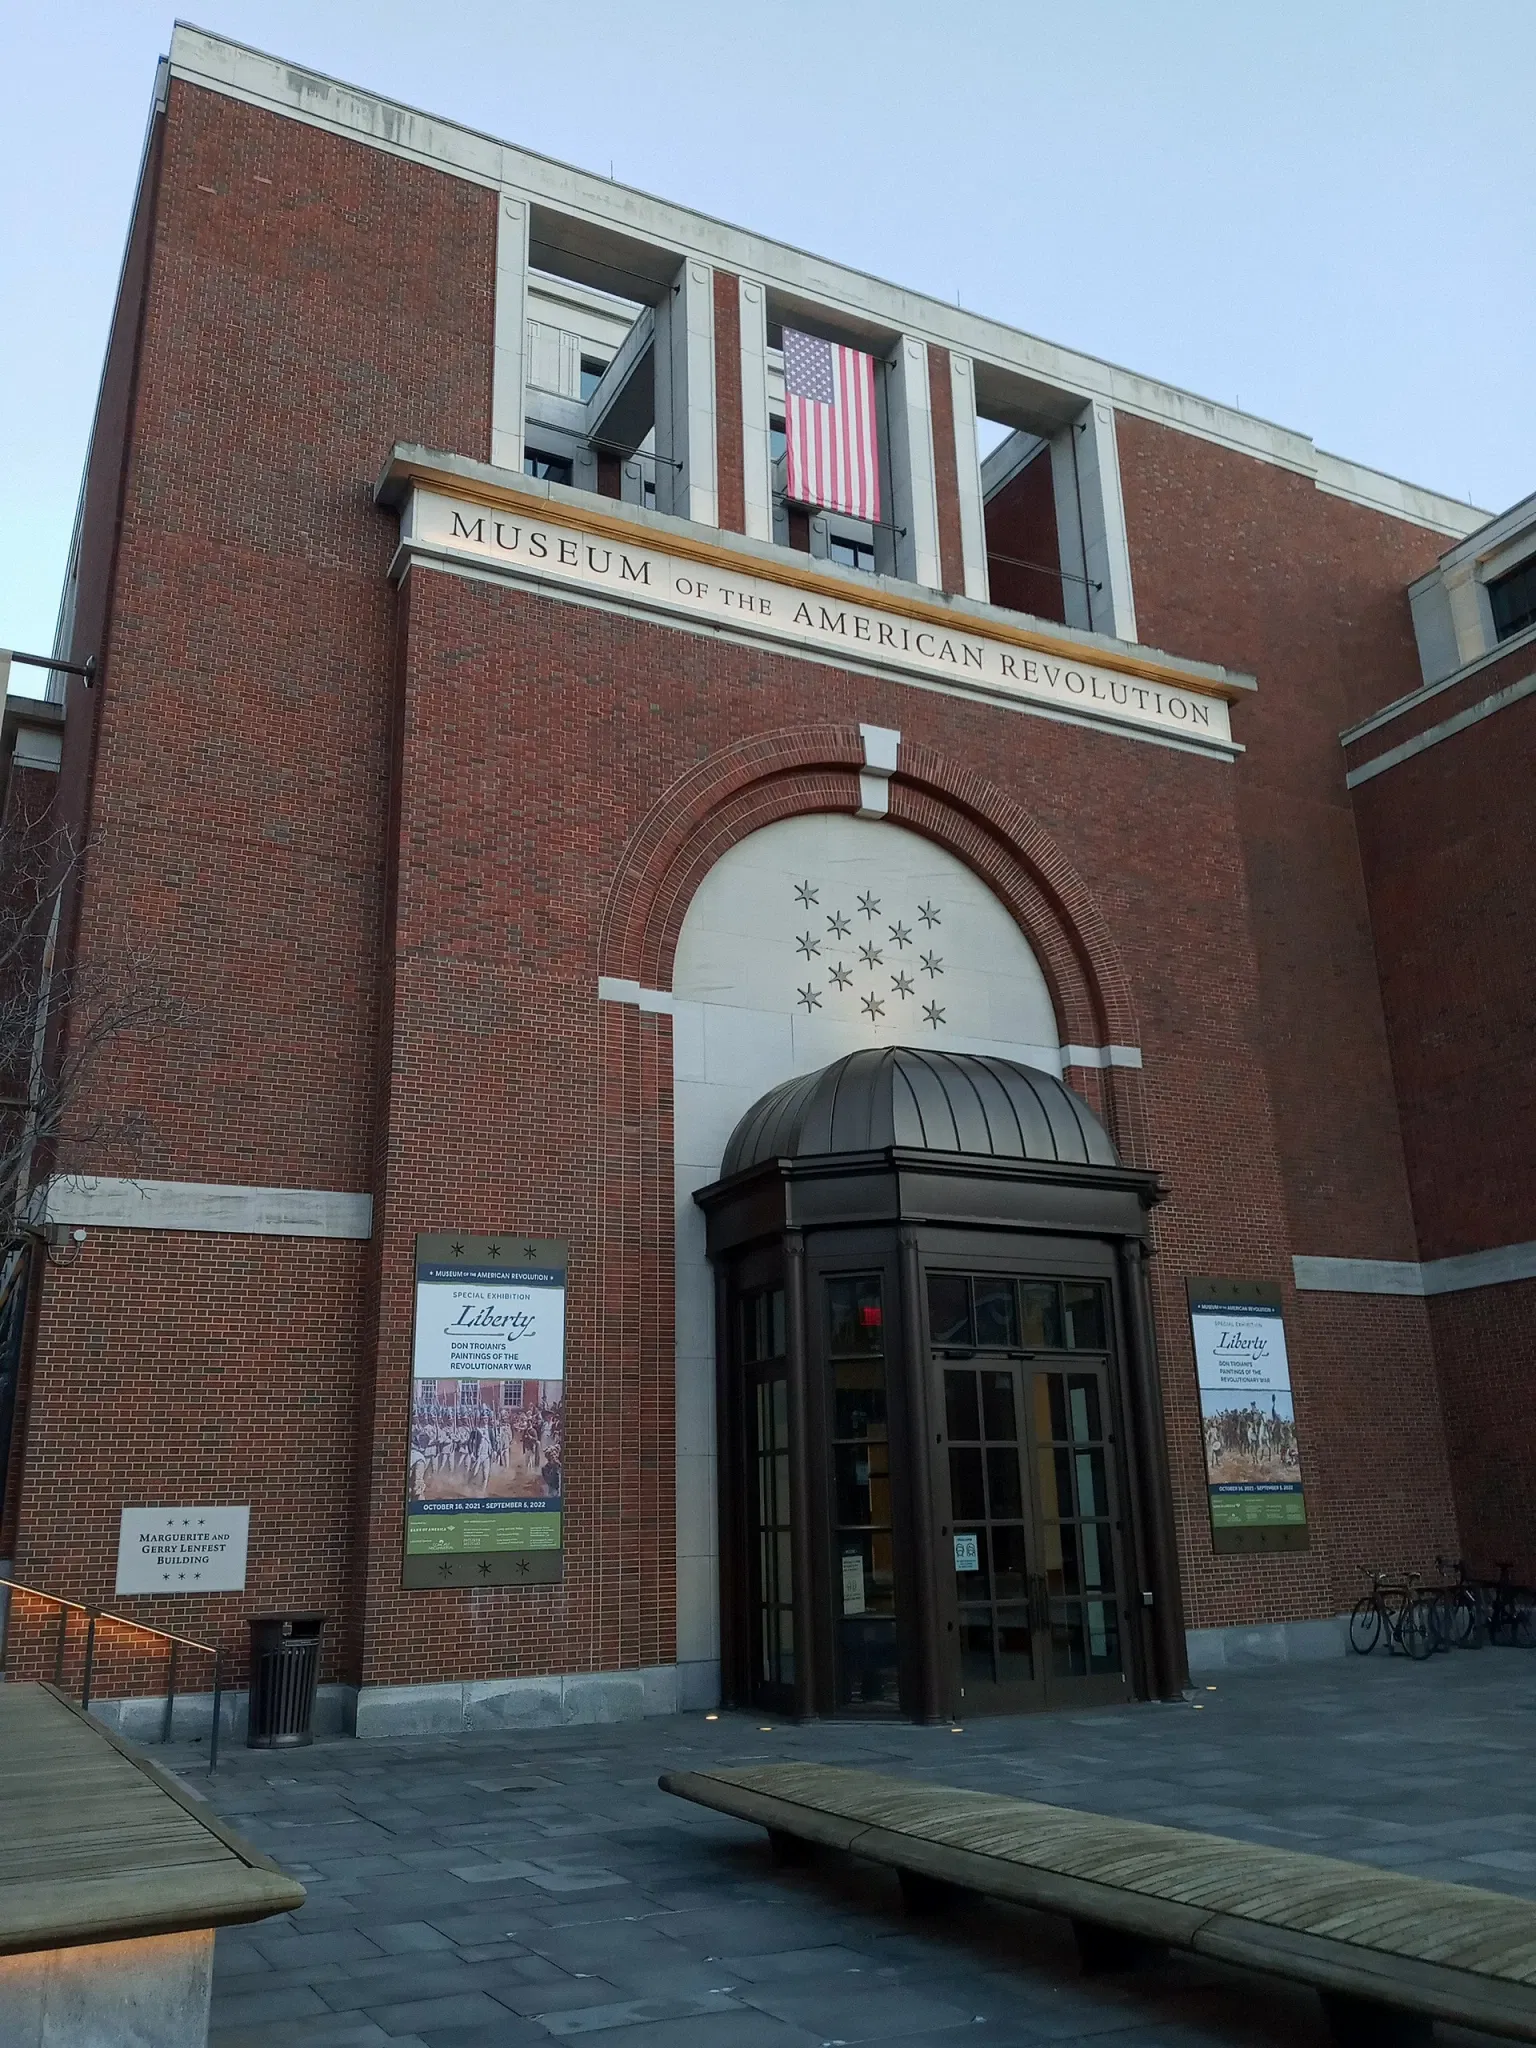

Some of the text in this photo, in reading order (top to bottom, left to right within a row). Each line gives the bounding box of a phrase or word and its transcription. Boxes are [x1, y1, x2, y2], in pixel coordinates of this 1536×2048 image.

[449, 510, 1211, 727] MUSEUM OF THE AMERICAN REVOLUTION
[477, 1271, 511, 1280] AMERICAN
[511, 1273, 549, 1281] REVOLUTION
[452, 1291, 531, 1300] SPECIAL EXHIBITION
[451, 1305, 536, 1341] Liberty
[470, 1342, 506, 1350] TROIANI'S
[1216, 1332, 1268, 1361] Liberty
[450, 1352, 491, 1360] PAINTINGS
[450, 1362, 532, 1371] REVOLUTIONARY WAR
[423, 1503, 454, 1511] OCTOBER
[465, 1502, 480, 1510] 2021
[139, 1533, 210, 1542] MARGUERITE
[142, 1544, 227, 1554] GERRY LENFEST
[156, 1556, 210, 1565] BUILDING
